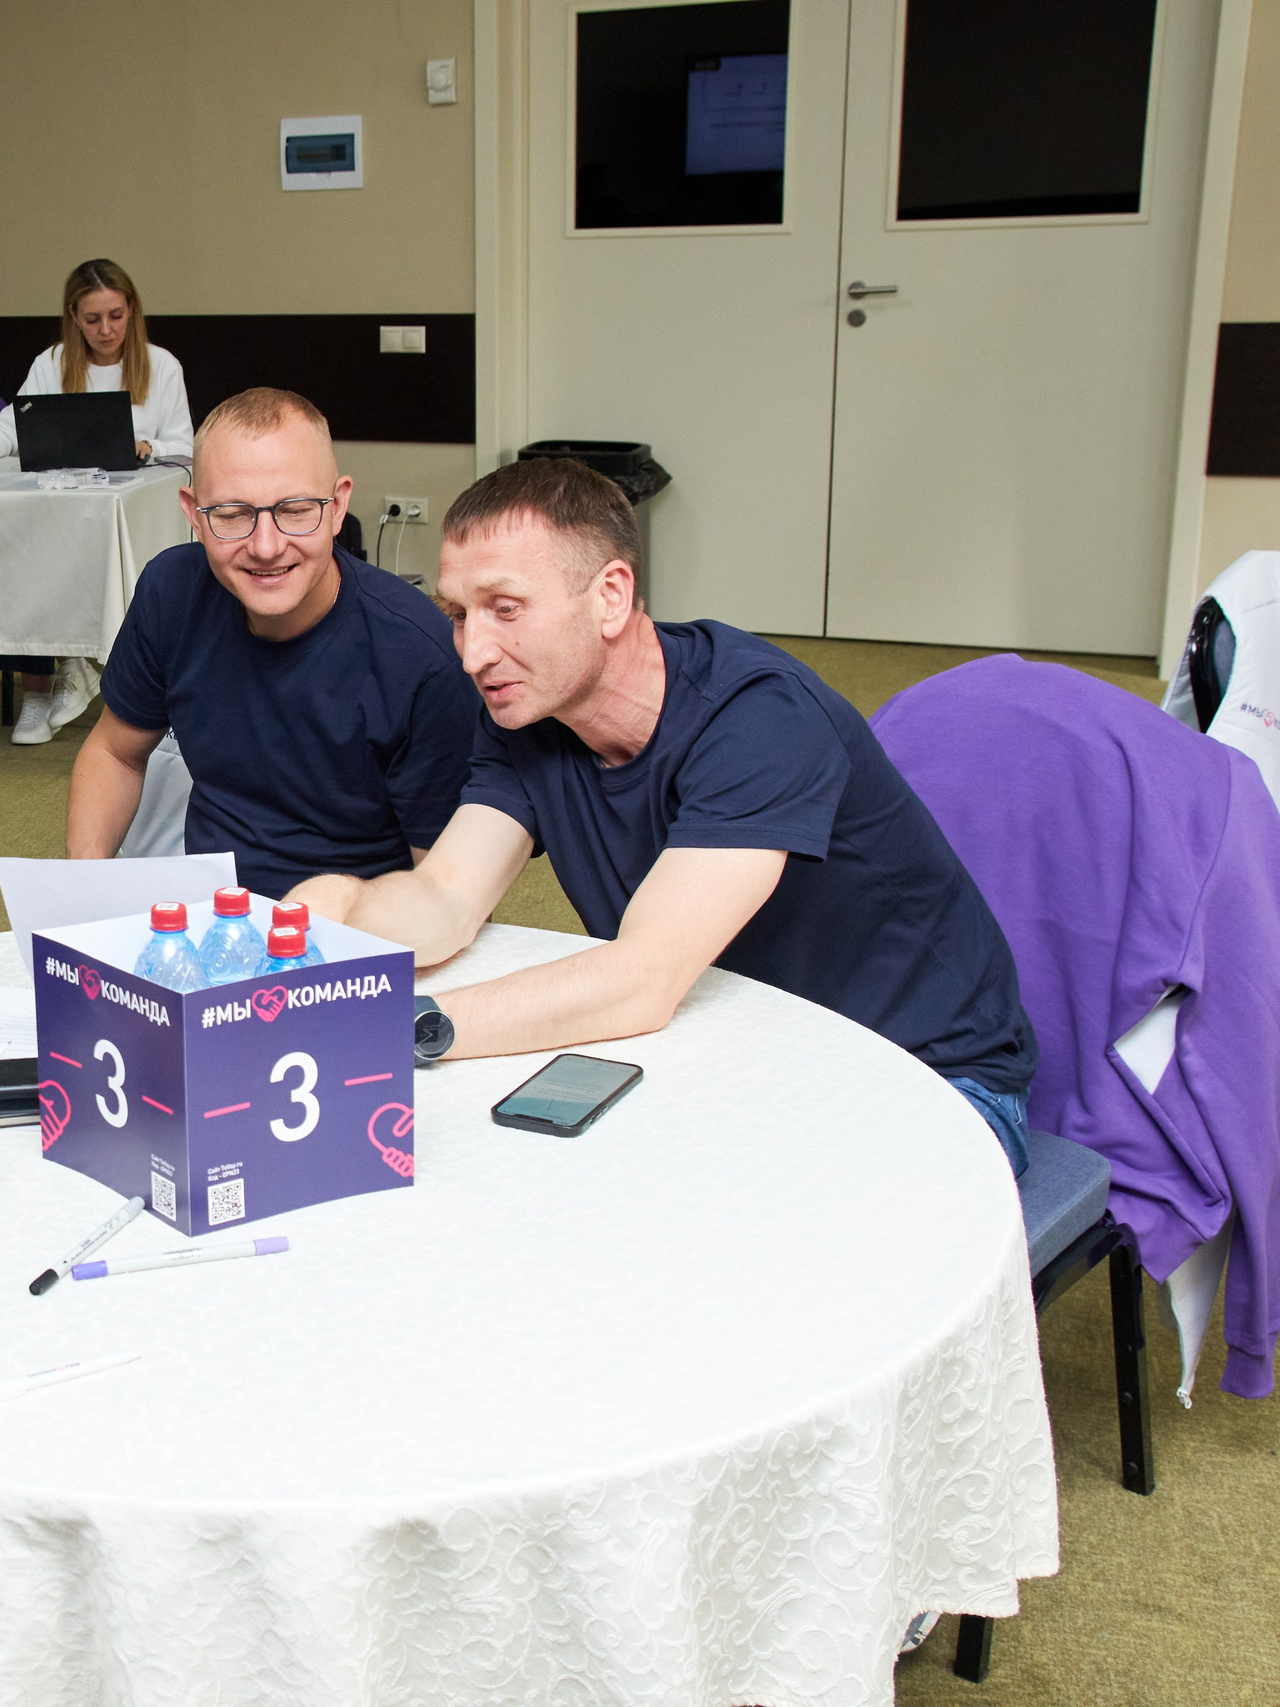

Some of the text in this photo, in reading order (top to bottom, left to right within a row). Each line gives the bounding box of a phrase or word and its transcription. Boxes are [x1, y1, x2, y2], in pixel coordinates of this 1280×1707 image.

[45, 956, 171, 1027] #МЫ КОМАНДА
[201, 973, 392, 1029] #МЫ КОМАНДА
[93, 1038, 129, 1129] 3
[269, 1051, 320, 1143] 3
